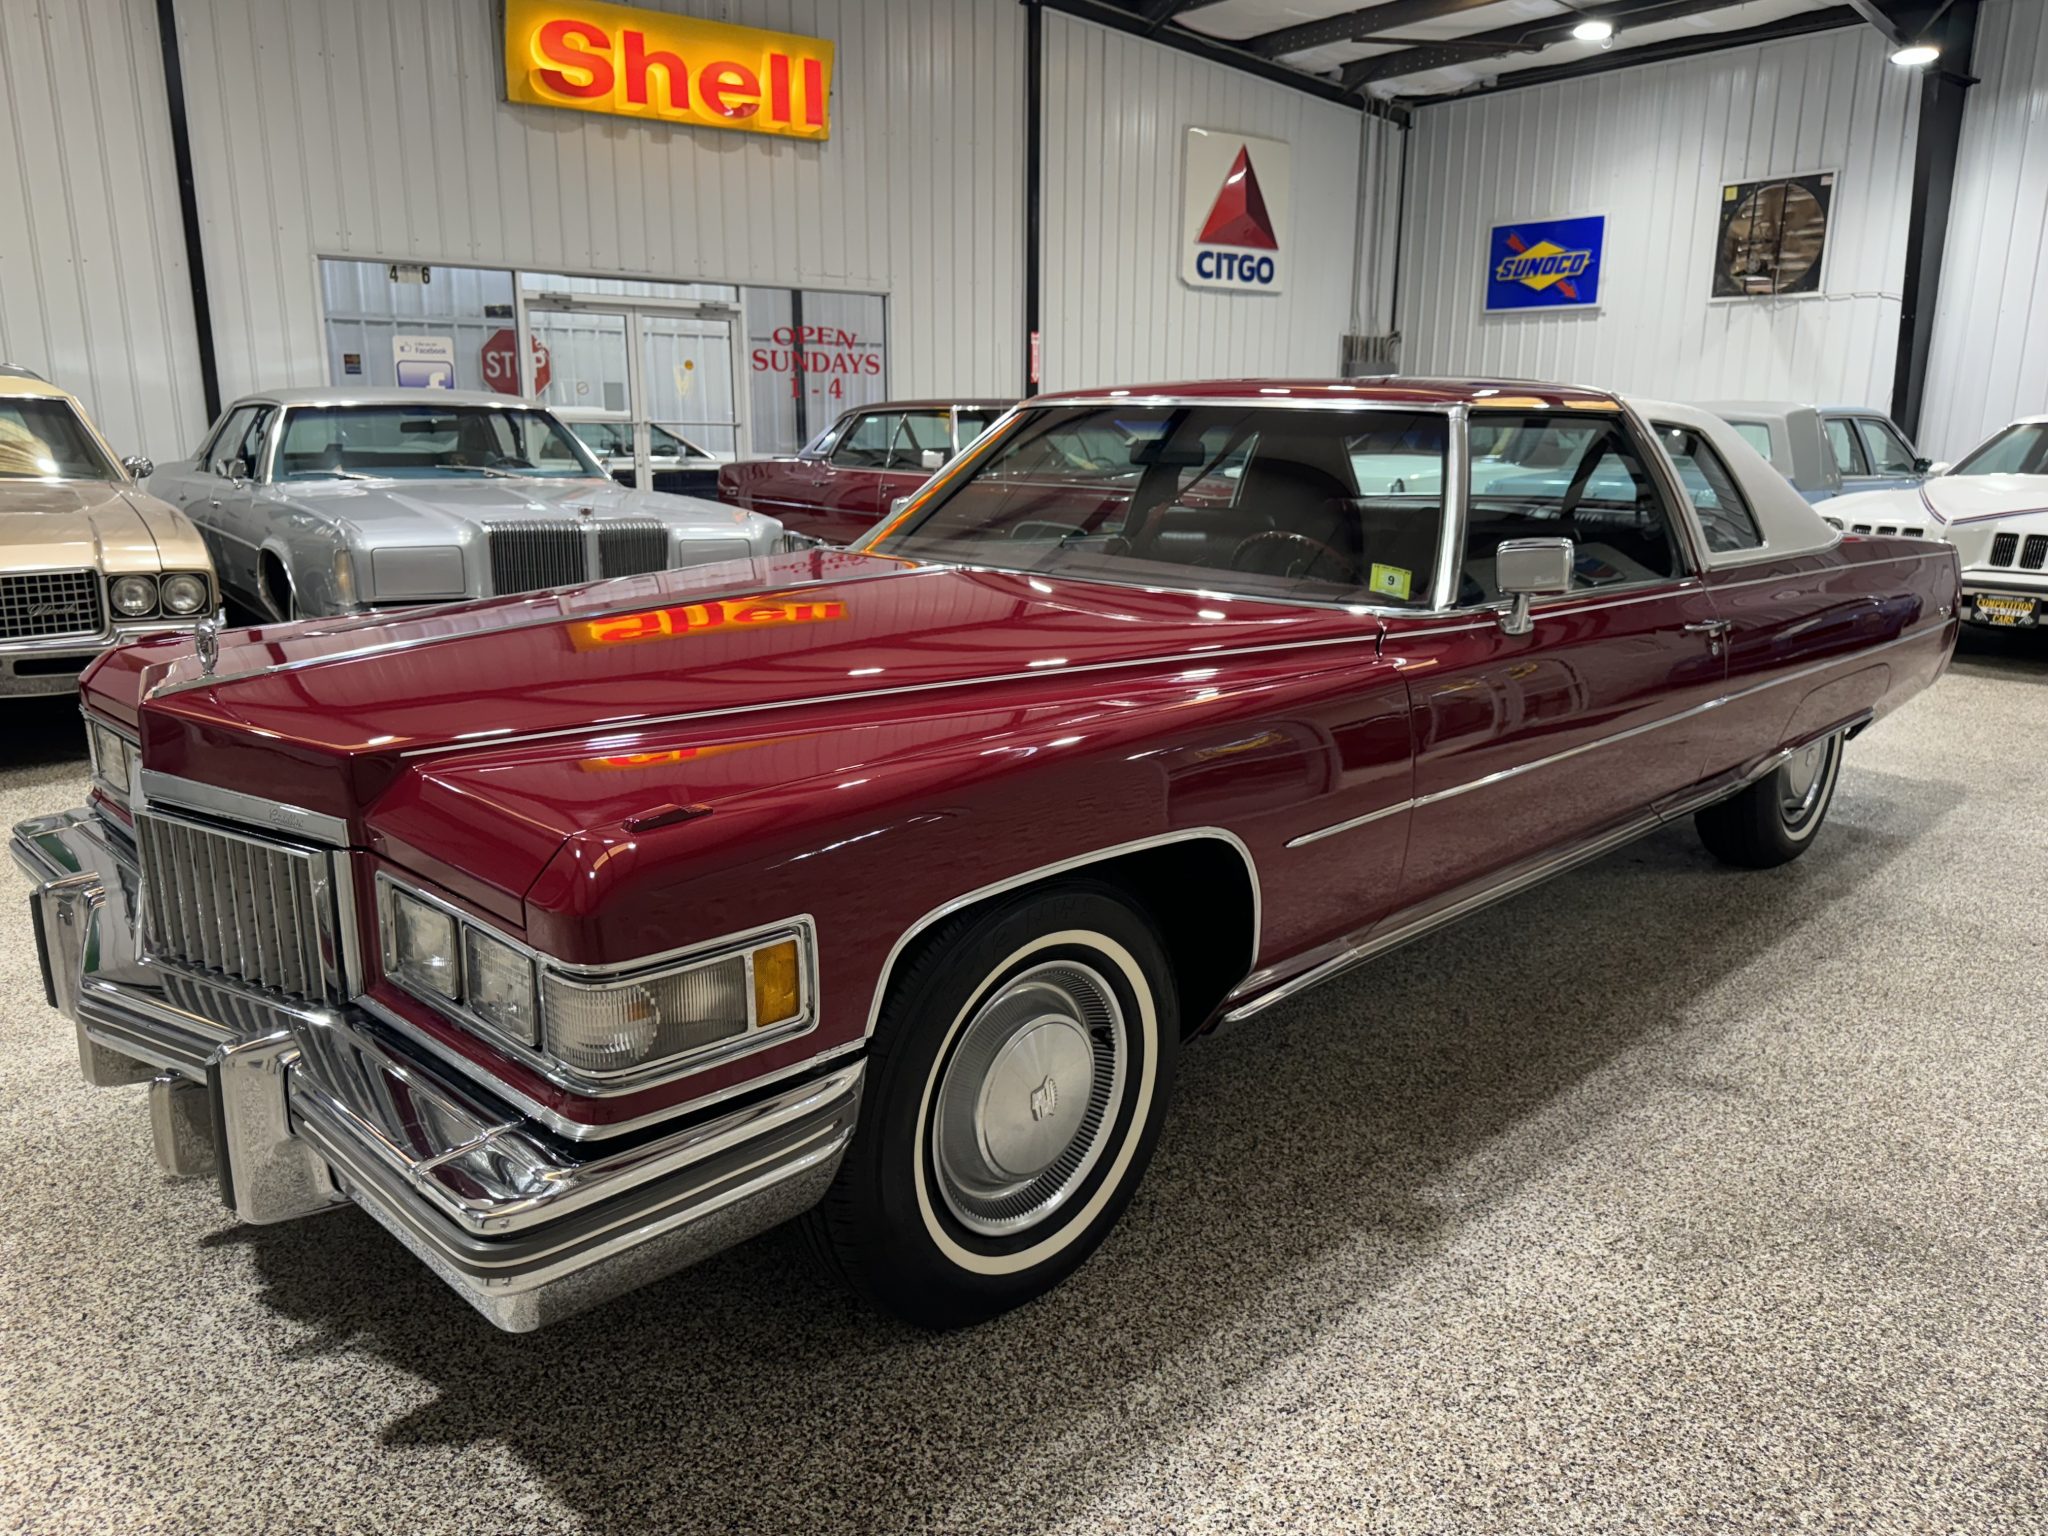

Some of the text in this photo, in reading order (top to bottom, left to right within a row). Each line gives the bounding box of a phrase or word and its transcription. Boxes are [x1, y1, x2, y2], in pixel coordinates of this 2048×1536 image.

[532, 19, 823, 129] Shell
[1196, 250, 1274, 285] CITGO
[1500, 254, 1587, 278] SUNOCO
[772, 325, 857, 350] OPEN
[486, 351, 546, 379] STP
[752, 349, 880, 375] SUNDAYS
[828, 377, 843, 400] 4
[1387, 575, 1395, 586] 9
[1977, 598, 2035, 612] COMPETITION
[1992, 614, 2015, 625] CARS
